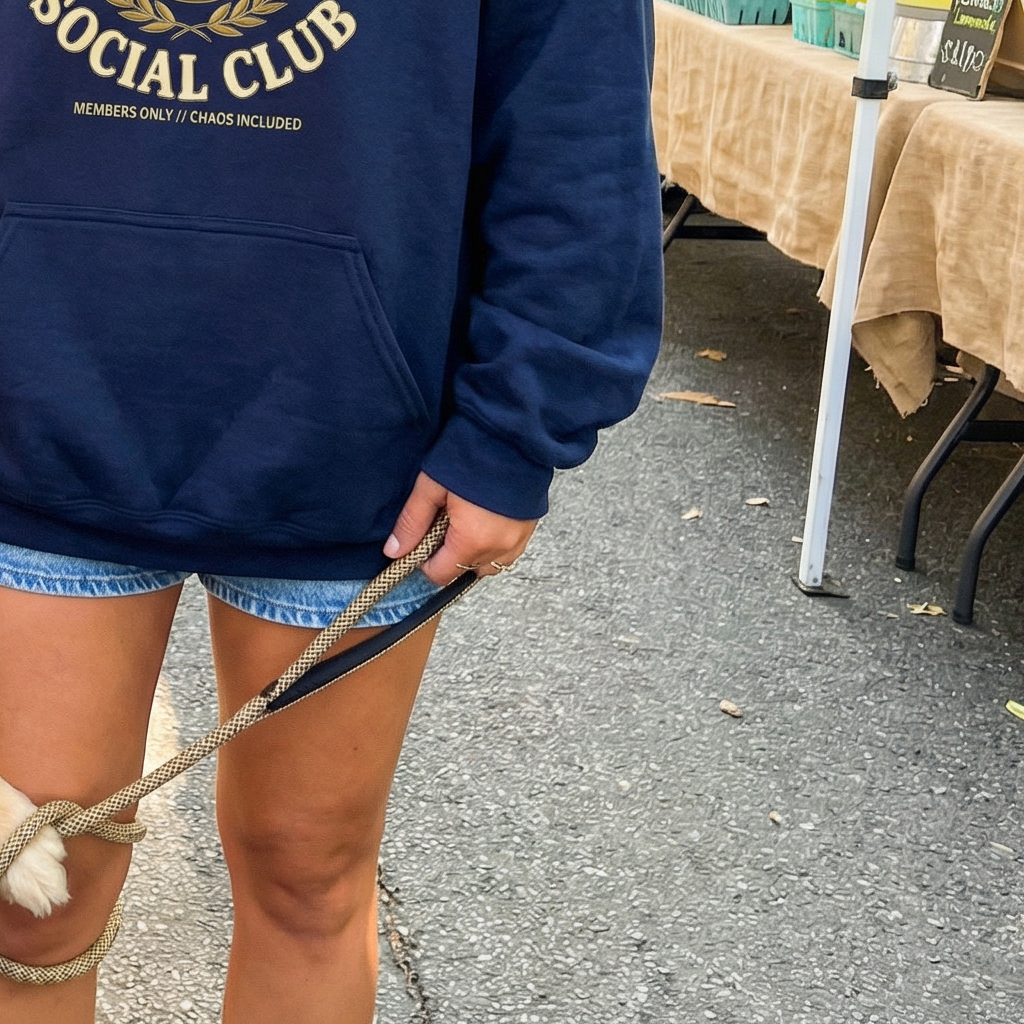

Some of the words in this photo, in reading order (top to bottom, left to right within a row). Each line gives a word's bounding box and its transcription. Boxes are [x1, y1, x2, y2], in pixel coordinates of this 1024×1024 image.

[73, 101, 137, 119] MEMBERS
[139, 106, 174, 121] ONLY
[175, 109, 188, 123] //
[189, 110, 234, 126] CHAOS
[236, 113, 302, 131] INCLUDED
